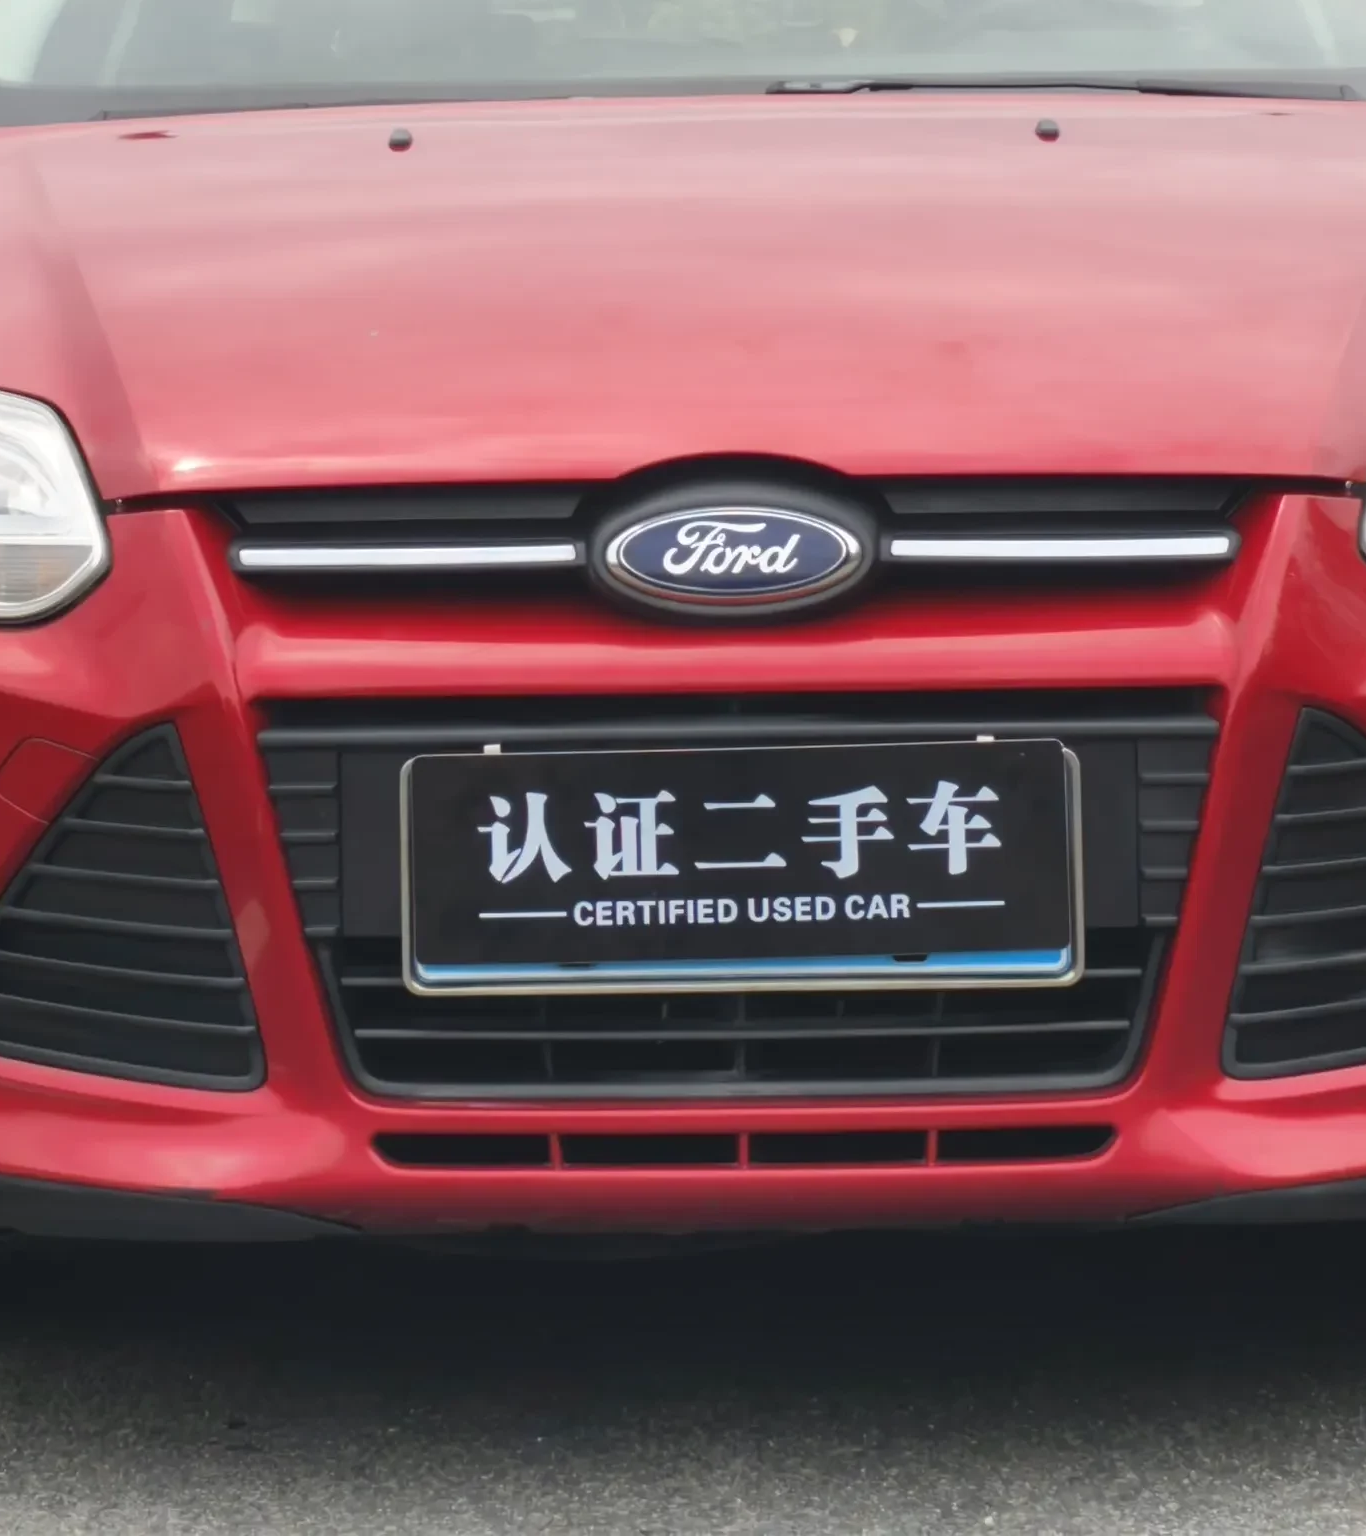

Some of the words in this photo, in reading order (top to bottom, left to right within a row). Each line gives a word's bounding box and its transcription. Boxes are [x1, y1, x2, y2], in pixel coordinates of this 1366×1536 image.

[662, 520, 801, 576] Ford
[477, 780, 1002, 884] 认证二手车
[572, 898, 738, 927] CERTIFIED
[746, 895, 837, 924] USED
[844, 893, 911, 921] CAR
